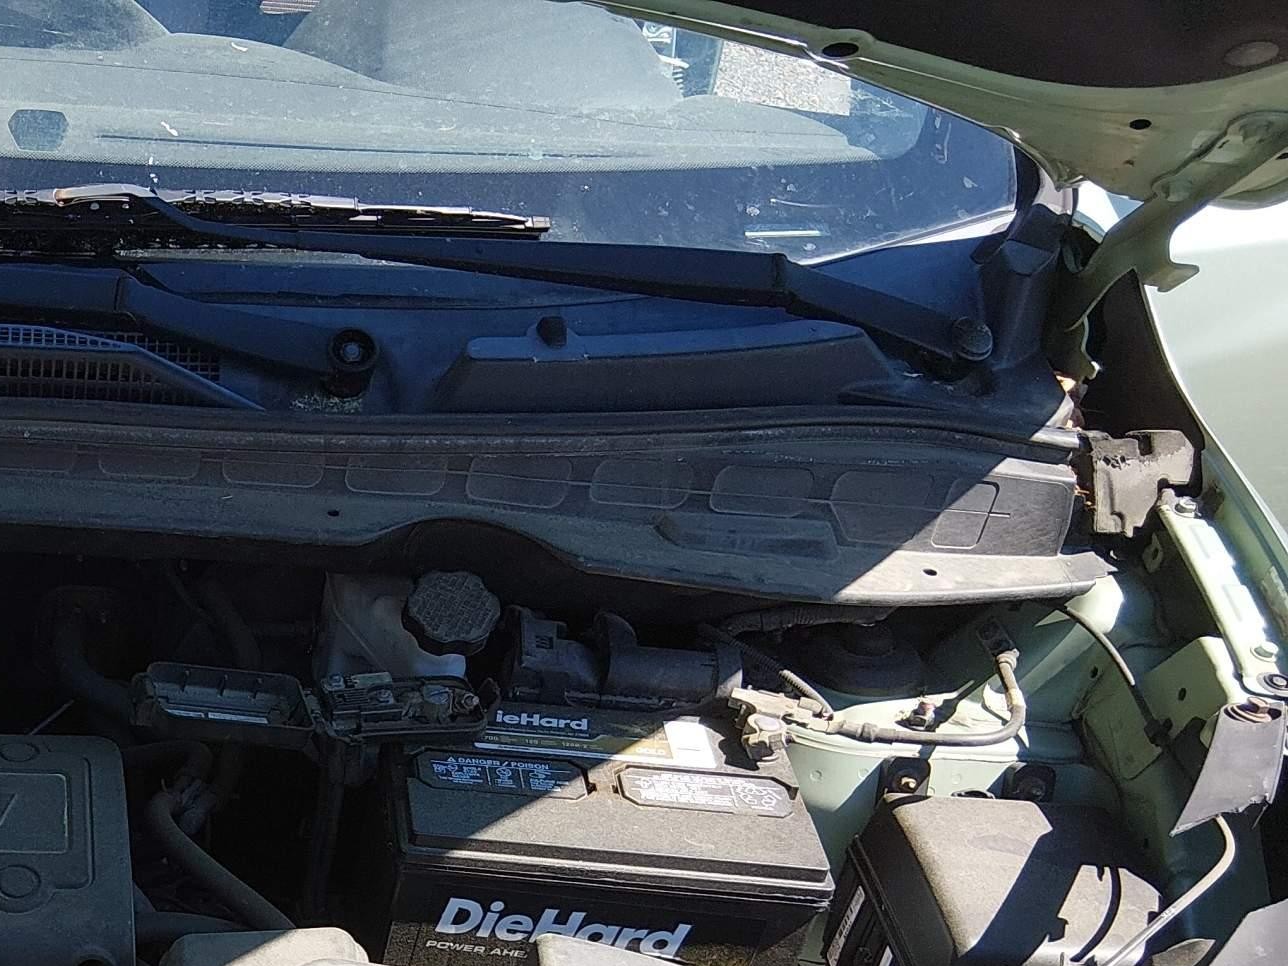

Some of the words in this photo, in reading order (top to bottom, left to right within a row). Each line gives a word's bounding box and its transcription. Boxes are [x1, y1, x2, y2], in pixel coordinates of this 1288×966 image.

[495, 710, 589, 731] ieHard
[458, 757, 501, 766] DANGER
[510, 761, 549, 770] POISON
[435, 897, 694, 959] DieHard
[426, 940, 485, 954] POWER
[489, 947, 528, 959] AHE
